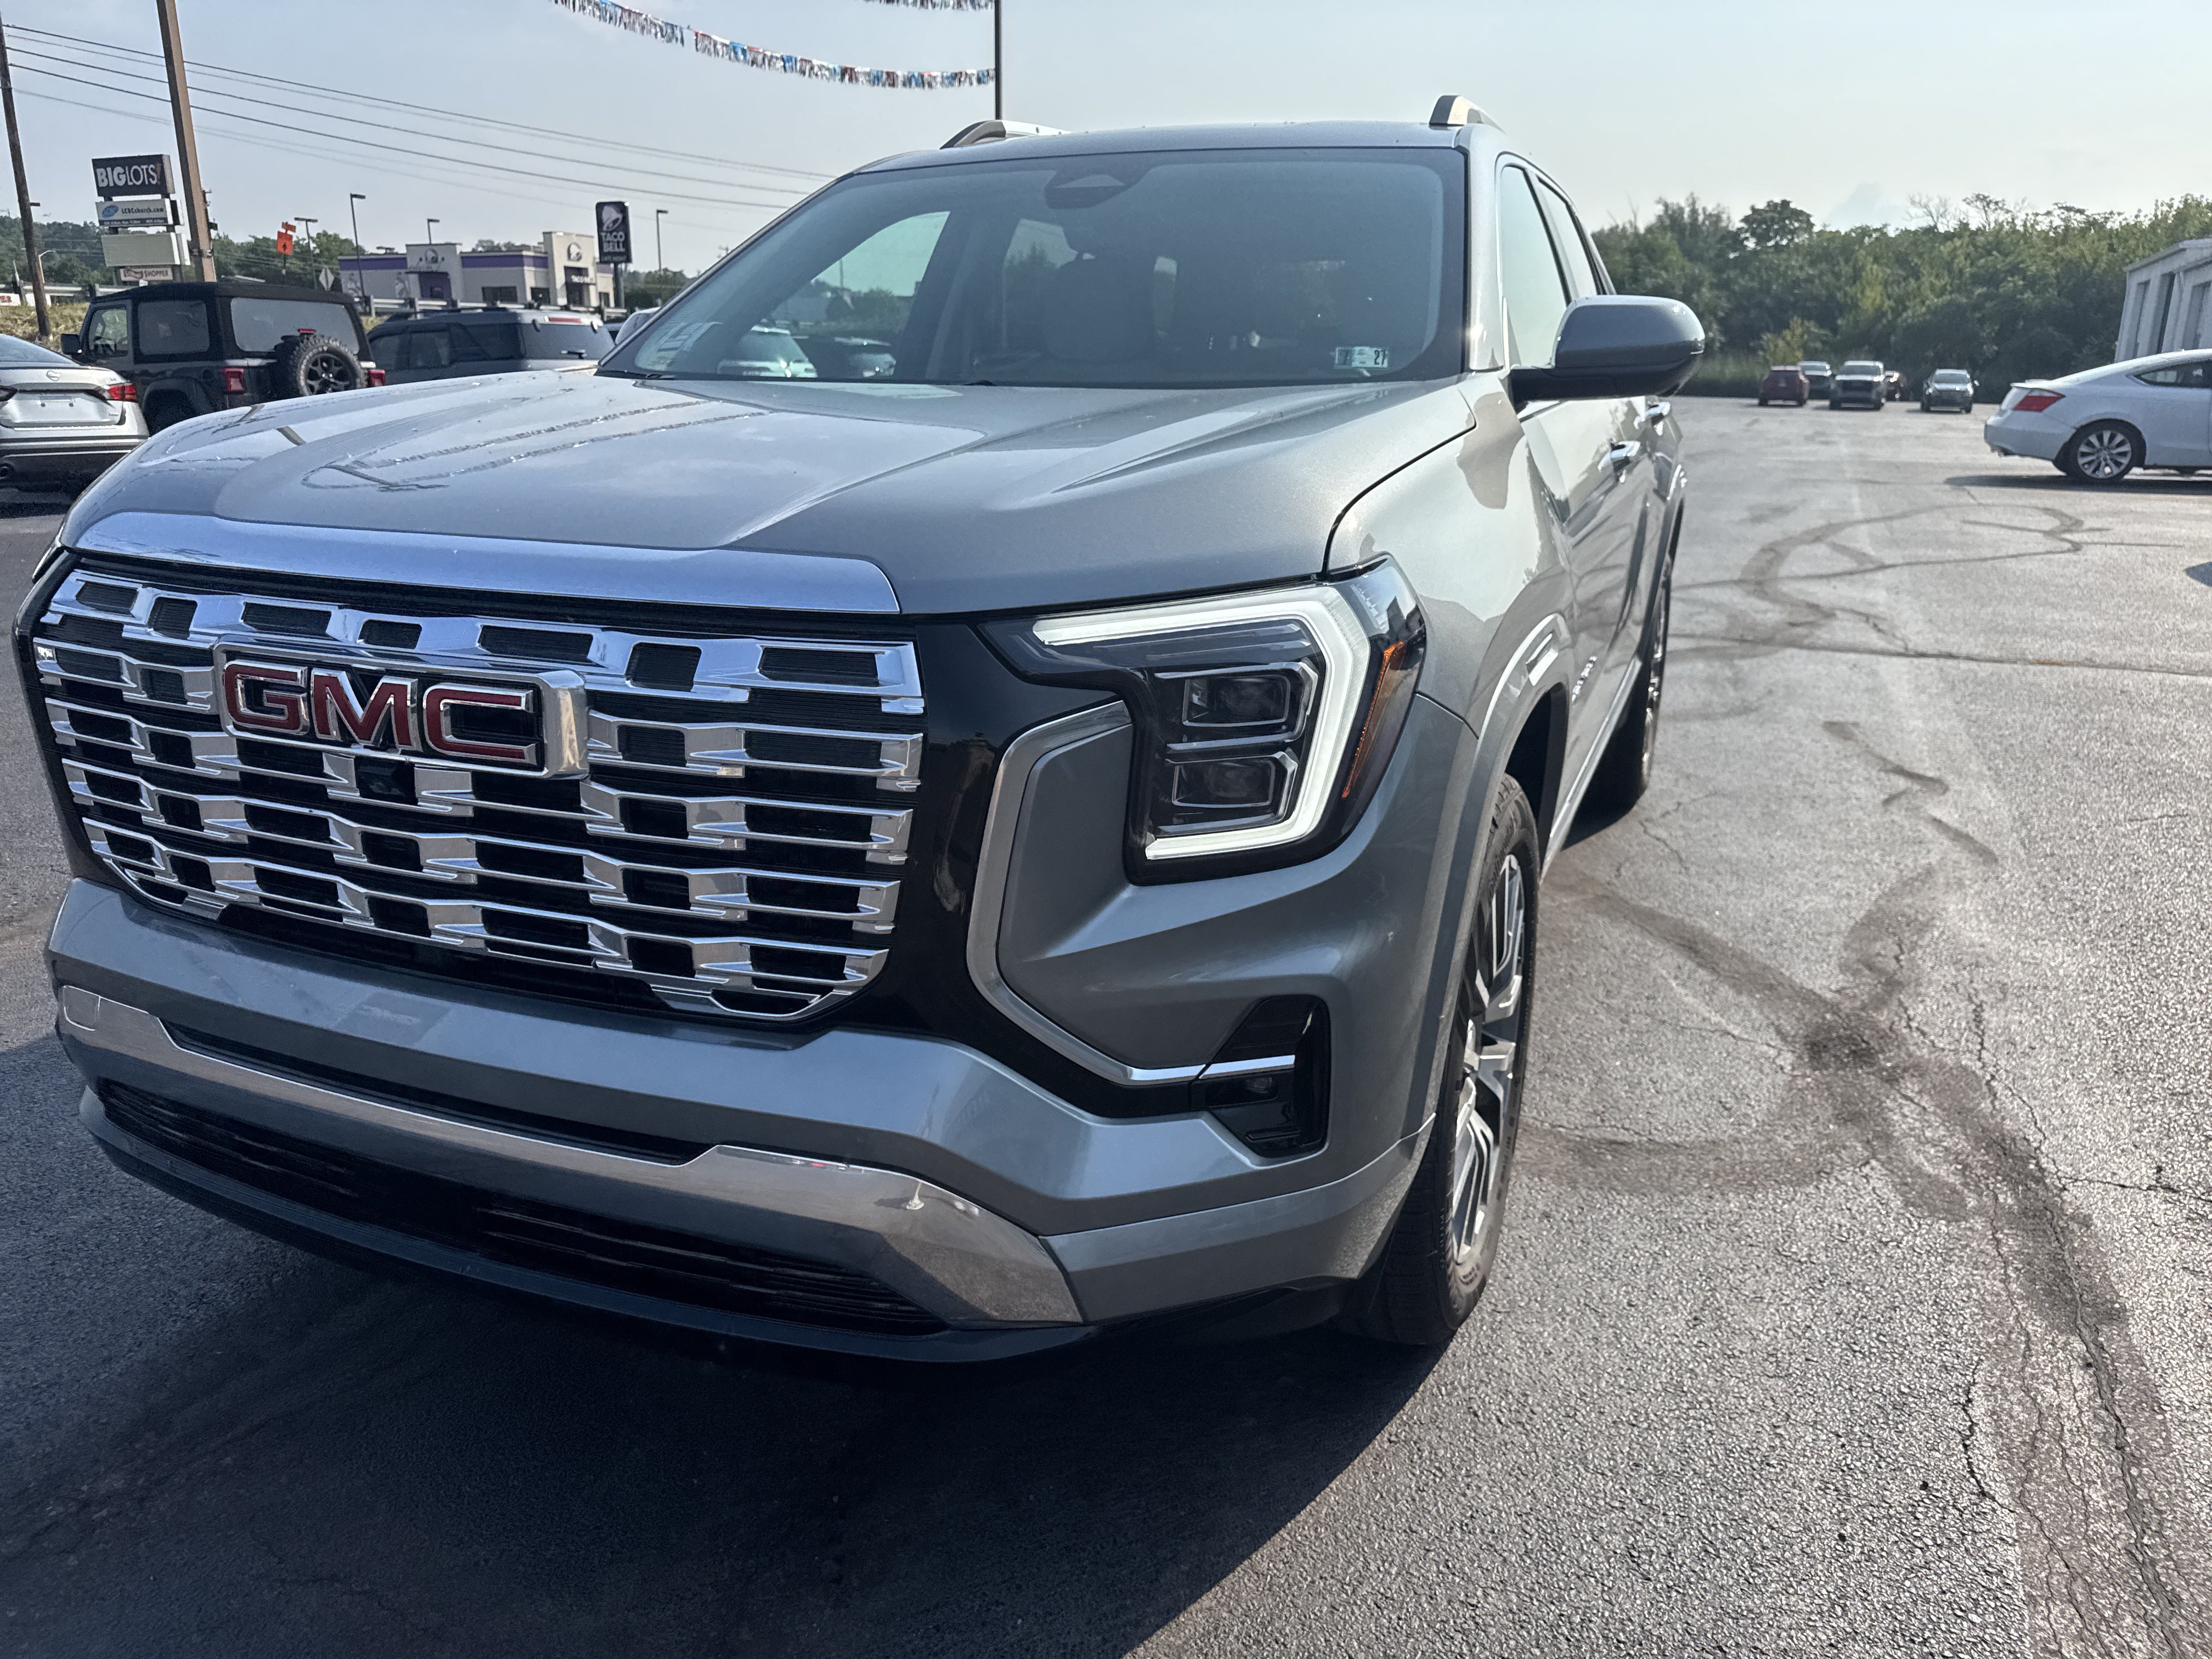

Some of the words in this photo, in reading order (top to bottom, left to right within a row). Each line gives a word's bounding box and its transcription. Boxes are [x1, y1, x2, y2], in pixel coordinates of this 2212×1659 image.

[600, 231, 625, 242] TACO
[603, 242, 626, 252] BELL
[1374, 349, 1386, 366] 27
[223, 660, 537, 766] GMC
